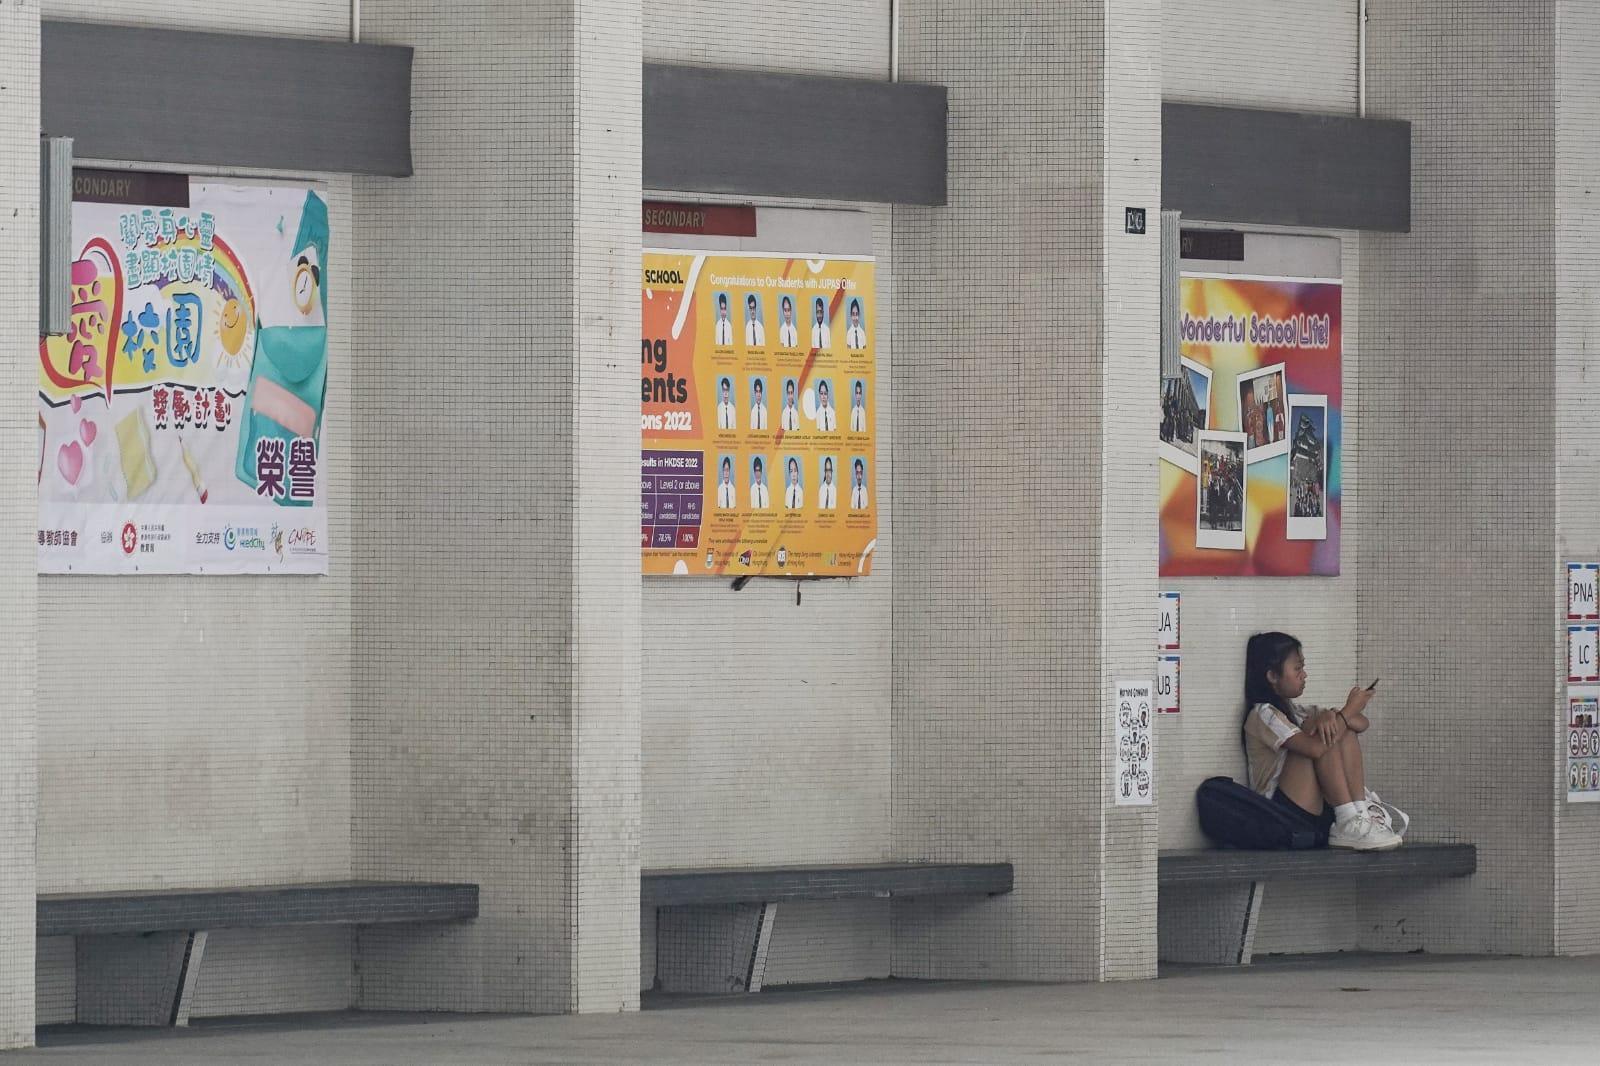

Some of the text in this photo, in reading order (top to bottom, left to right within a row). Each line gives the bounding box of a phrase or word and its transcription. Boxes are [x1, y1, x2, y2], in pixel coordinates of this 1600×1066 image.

[645, 208, 706, 228] SECONDARY
[645, 269, 684, 285] SCHOOL
[757, 276, 765, 287] to
[765, 276, 777, 288] Our
[777, 276, 804, 289] Students
[804, 278, 818, 289] with
[1249, 313, 1297, 345] School
[153, 387, 231, 429] 獎勵計劃
[664, 410, 692, 431] 2022
[256, 438, 317, 498] 榮譽
[657, 457, 664, 468] in
[664, 457, 684, 468] HKDSE
[684, 458, 698, 468] 2022
[660, 480, 674, 490] Level
[679, 482, 685, 490] or
[685, 480, 700, 490] above
[195, 531, 220, 545] 全力支持
[1573, 582, 1594, 602] PNA
[1578, 645, 1590, 664] LC
[1157, 674, 1171, 695] UB
